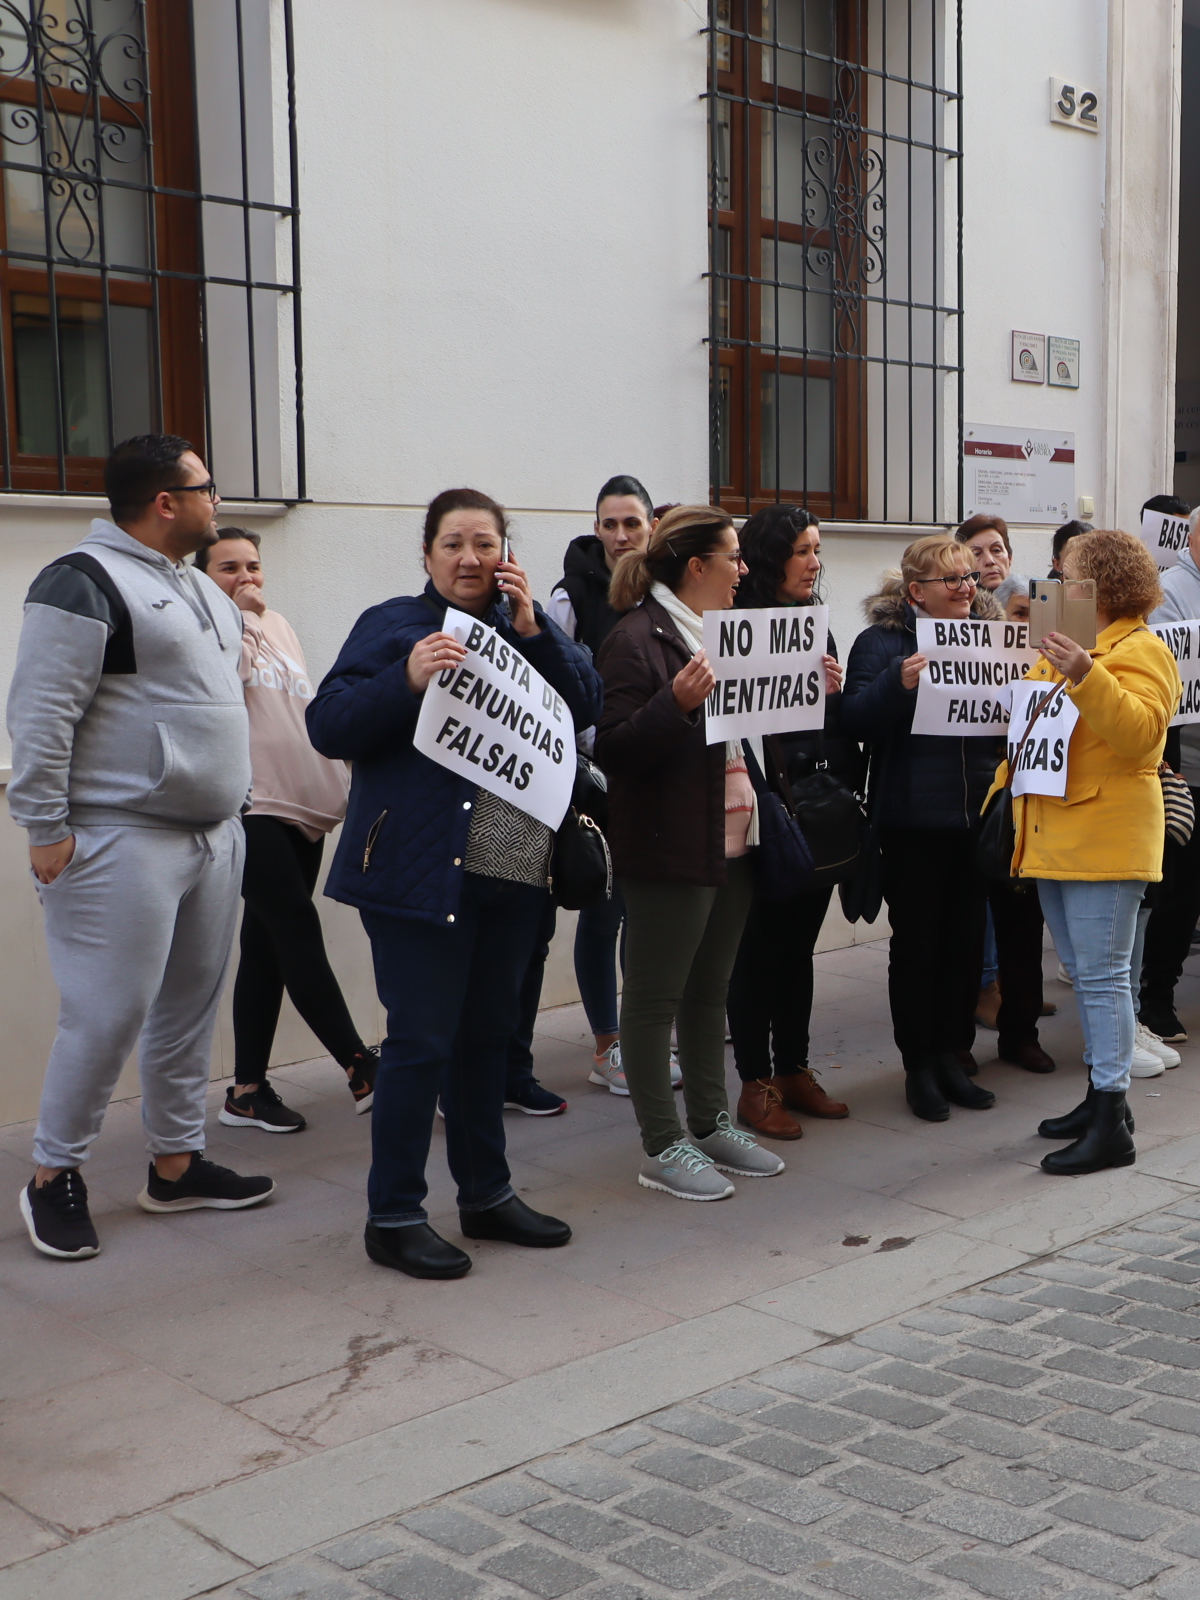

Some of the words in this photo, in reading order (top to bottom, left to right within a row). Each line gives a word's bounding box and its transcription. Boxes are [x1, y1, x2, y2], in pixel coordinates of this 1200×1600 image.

[1057, 84, 1098, 122] 52
[974, 447, 992, 456] Horario
[1158, 518, 1190, 551] BAST
[719, 620, 753, 657] NO
[769, 616, 815, 654] MAS
[934, 622, 992, 648] BASTA
[1004, 625, 1028, 649] DE
[465, 622, 531, 694] BASTA
[541, 683, 563, 723] DE
[928, 660, 1030, 686] DENUNCIAS
[707, 670, 820, 718] MENTIRAS
[437, 667, 564, 765] DENUNCIAS
[435, 715, 534, 791] FALSAS
